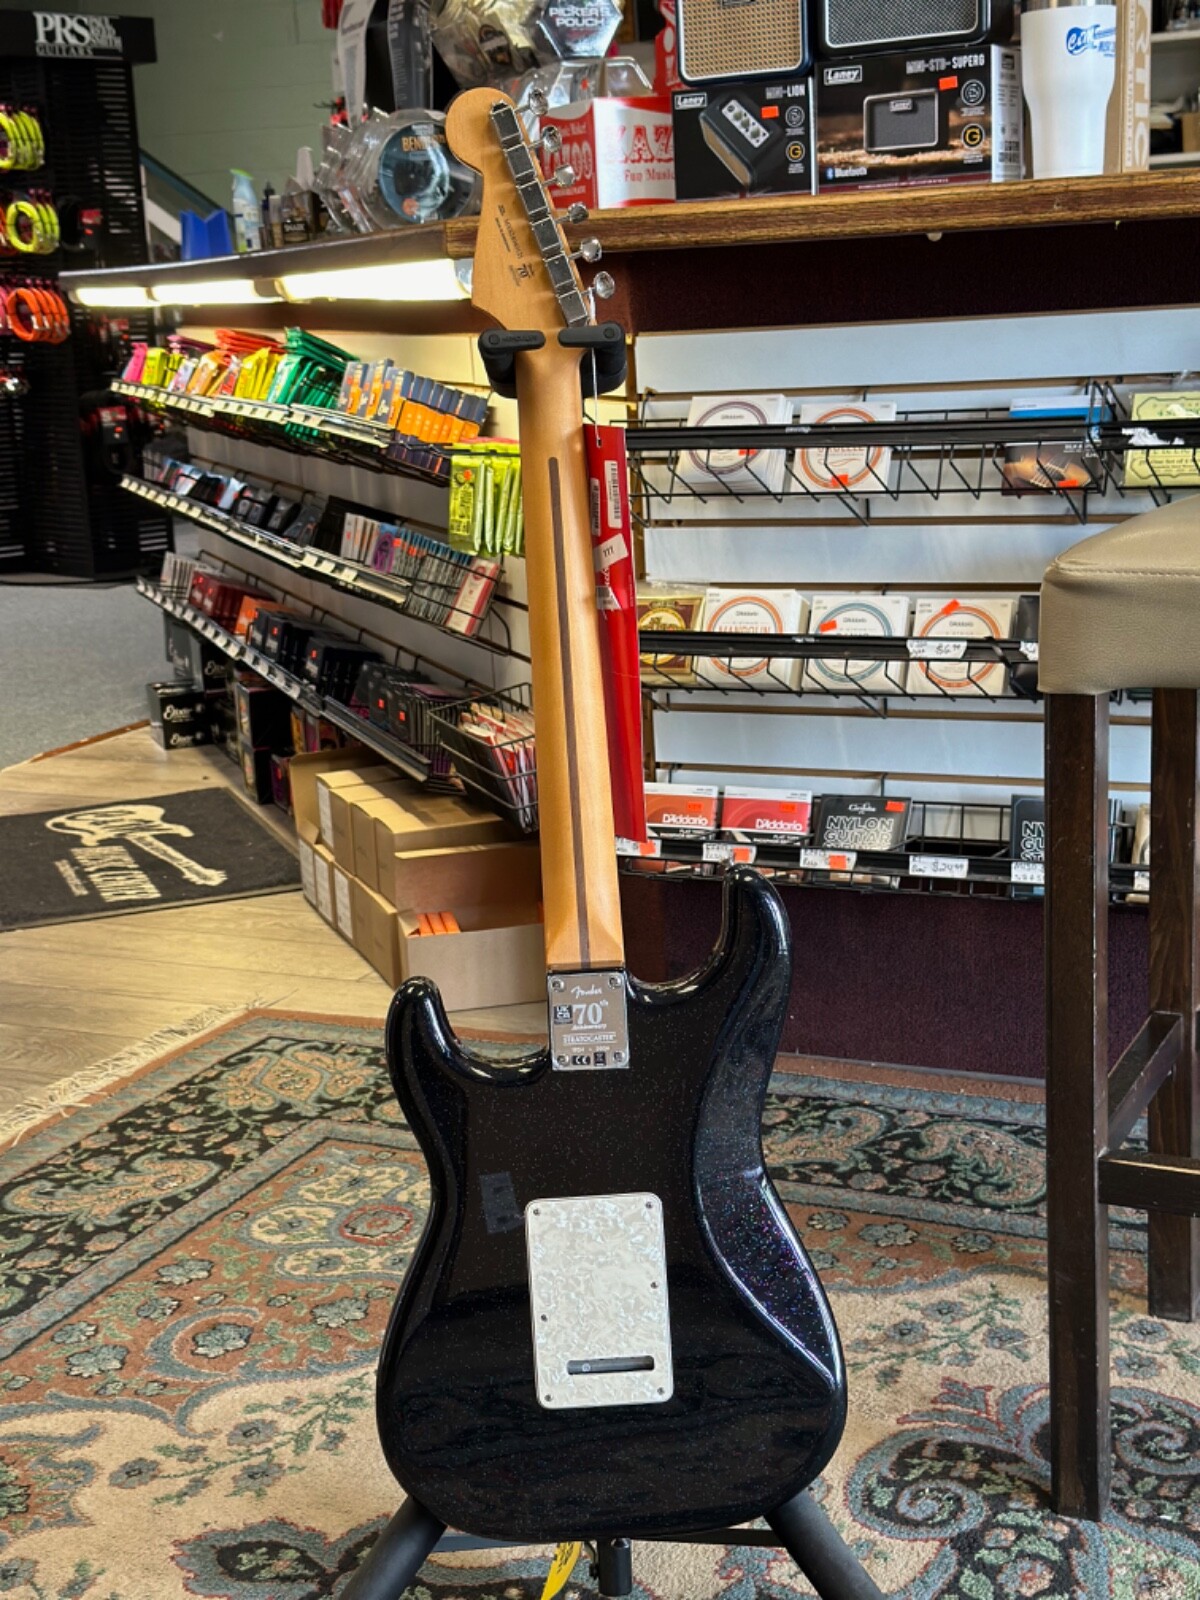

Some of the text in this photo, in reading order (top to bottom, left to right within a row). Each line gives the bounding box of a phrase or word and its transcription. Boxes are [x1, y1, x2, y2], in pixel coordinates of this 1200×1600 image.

[32, 11, 91, 45] PRS
[556, 18, 604, 27] POUCH
[825, 67, 859, 83] Laney
[662, 813, 709, 826] D'Addario
[755, 818, 803, 832] D'Addario
[826, 815, 895, 833] NYLON
[823, 830, 893, 845] GUITAR
[570, 984, 602, 999] Fender
